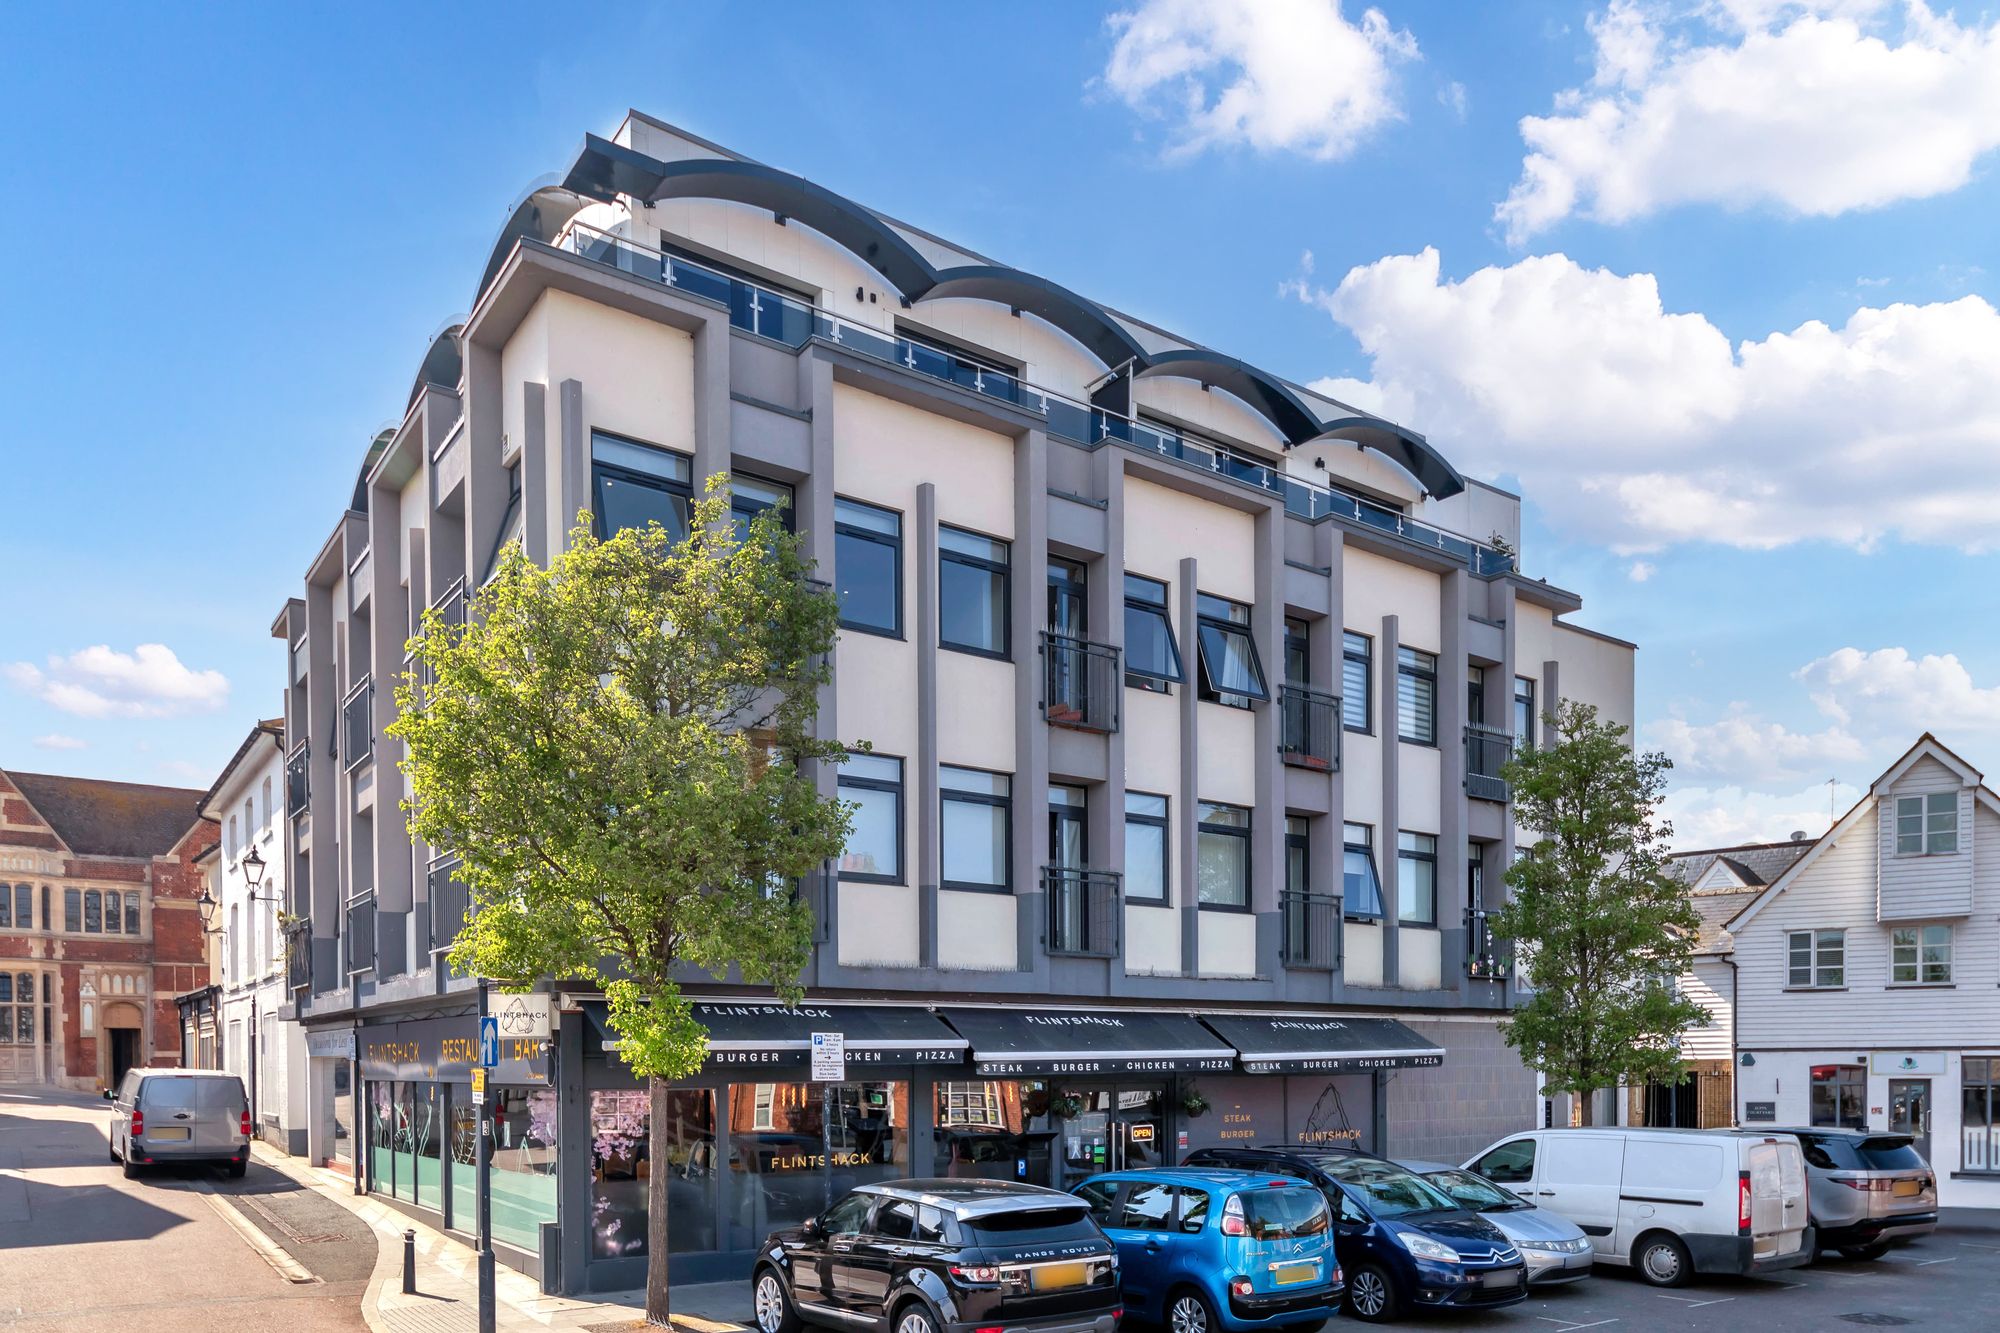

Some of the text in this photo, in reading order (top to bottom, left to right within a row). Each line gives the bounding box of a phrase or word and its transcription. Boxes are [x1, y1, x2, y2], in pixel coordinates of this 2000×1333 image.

[700, 1006, 832, 1018] FLINTSHACK
[1026, 1016, 1124, 1027] FLINTSHACK
[1270, 1021, 1348, 1030] FLINTSHACK
[369, 1042, 420, 1063] FLINTSHACK
[514, 1039, 540, 1061] BAR
[716, 1051, 955, 1062] BURGER CKEN PIZZA
[983, 1061, 1230, 1073] STEAK BURGER CHICKEN PIZZA
[1251, 1058, 1439, 1071] STEAK BURGER CHICKEN PIZZA
[1224, 1114, 1251, 1123] STEAK
[1133, 1128, 1152, 1138] OPEN
[1220, 1130, 1255, 1139] BURGER
[1299, 1129, 1361, 1143] FLINTSHACK
[771, 1153, 870, 1169] FLINTSHACK
[1018, 1161, 1025, 1174] P
[1014, 1246, 1096, 1259] RANGE ROVER
